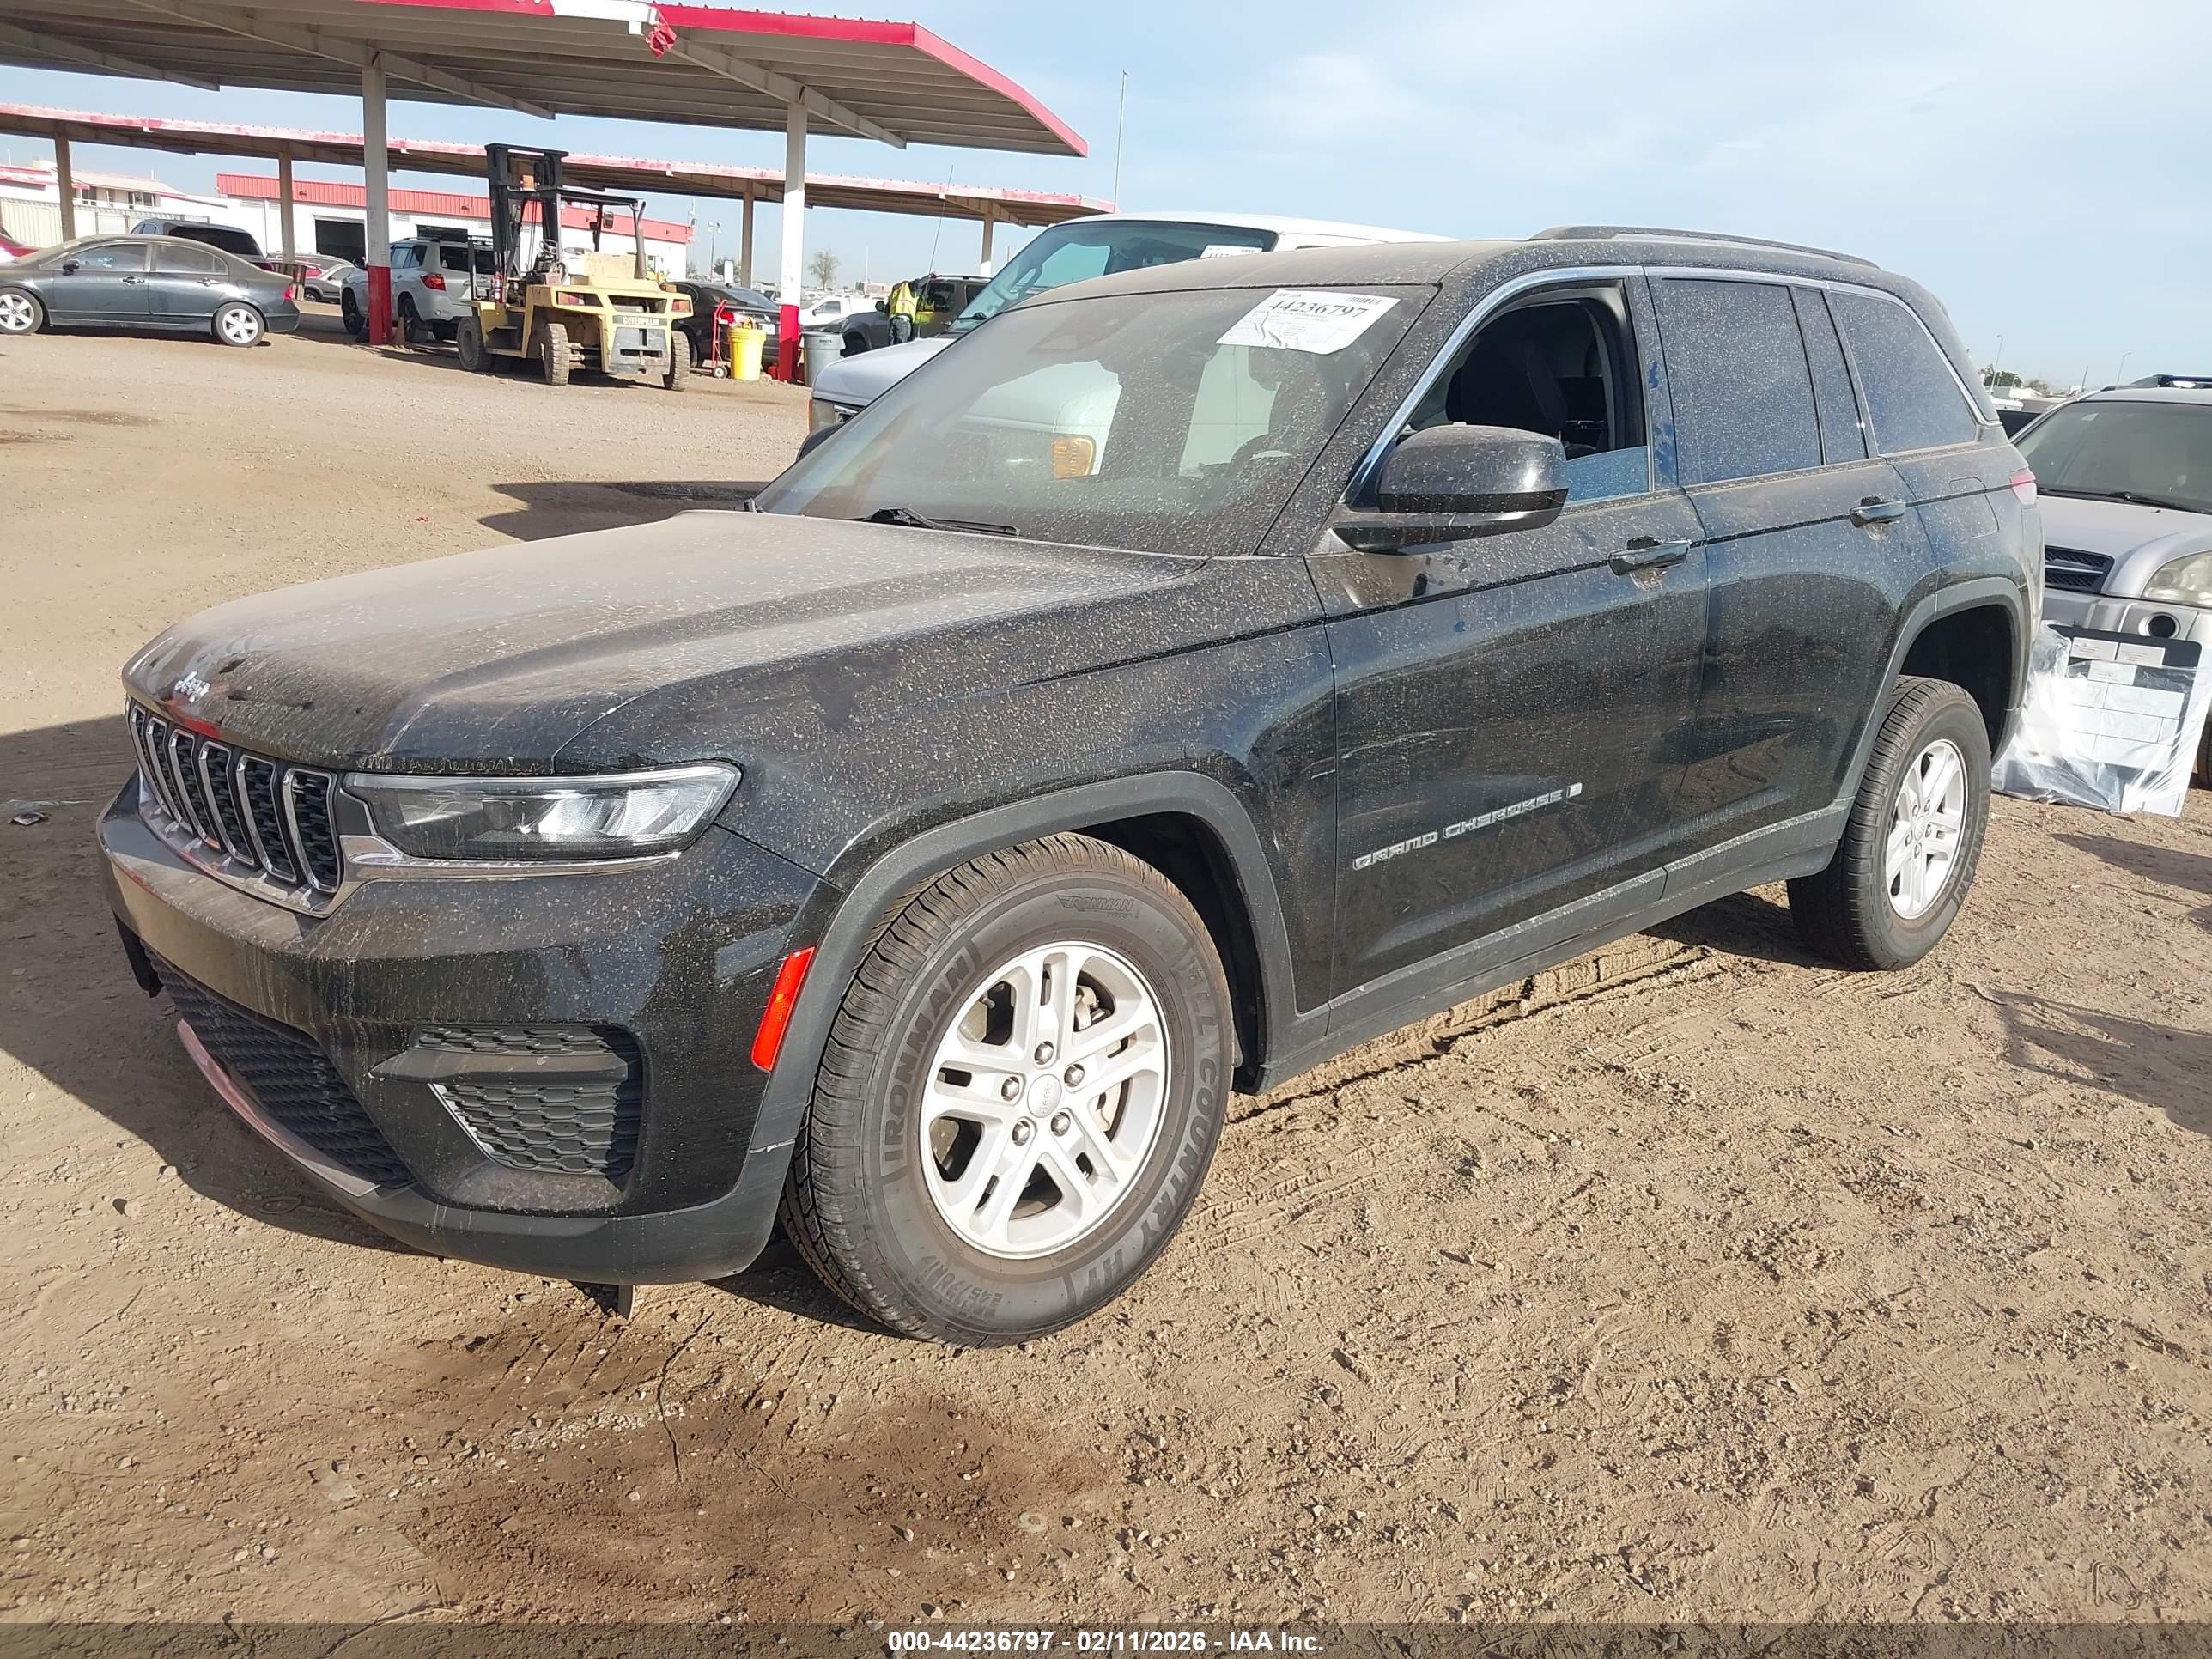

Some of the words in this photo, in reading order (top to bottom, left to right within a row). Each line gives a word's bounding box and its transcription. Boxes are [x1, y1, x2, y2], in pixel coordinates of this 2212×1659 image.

[623, 315, 660, 326] CATERPILLAR
[1269, 300, 1369, 319] 44236797
[1352, 831, 1438, 871] GRAND
[1443, 789, 1563, 839] CHEROKEE
[1055, 894, 1134, 912] IRONMAN
[884, 956, 971, 1162] IRONMAN
[1140, 1057, 1218, 1250] COUNTRY
